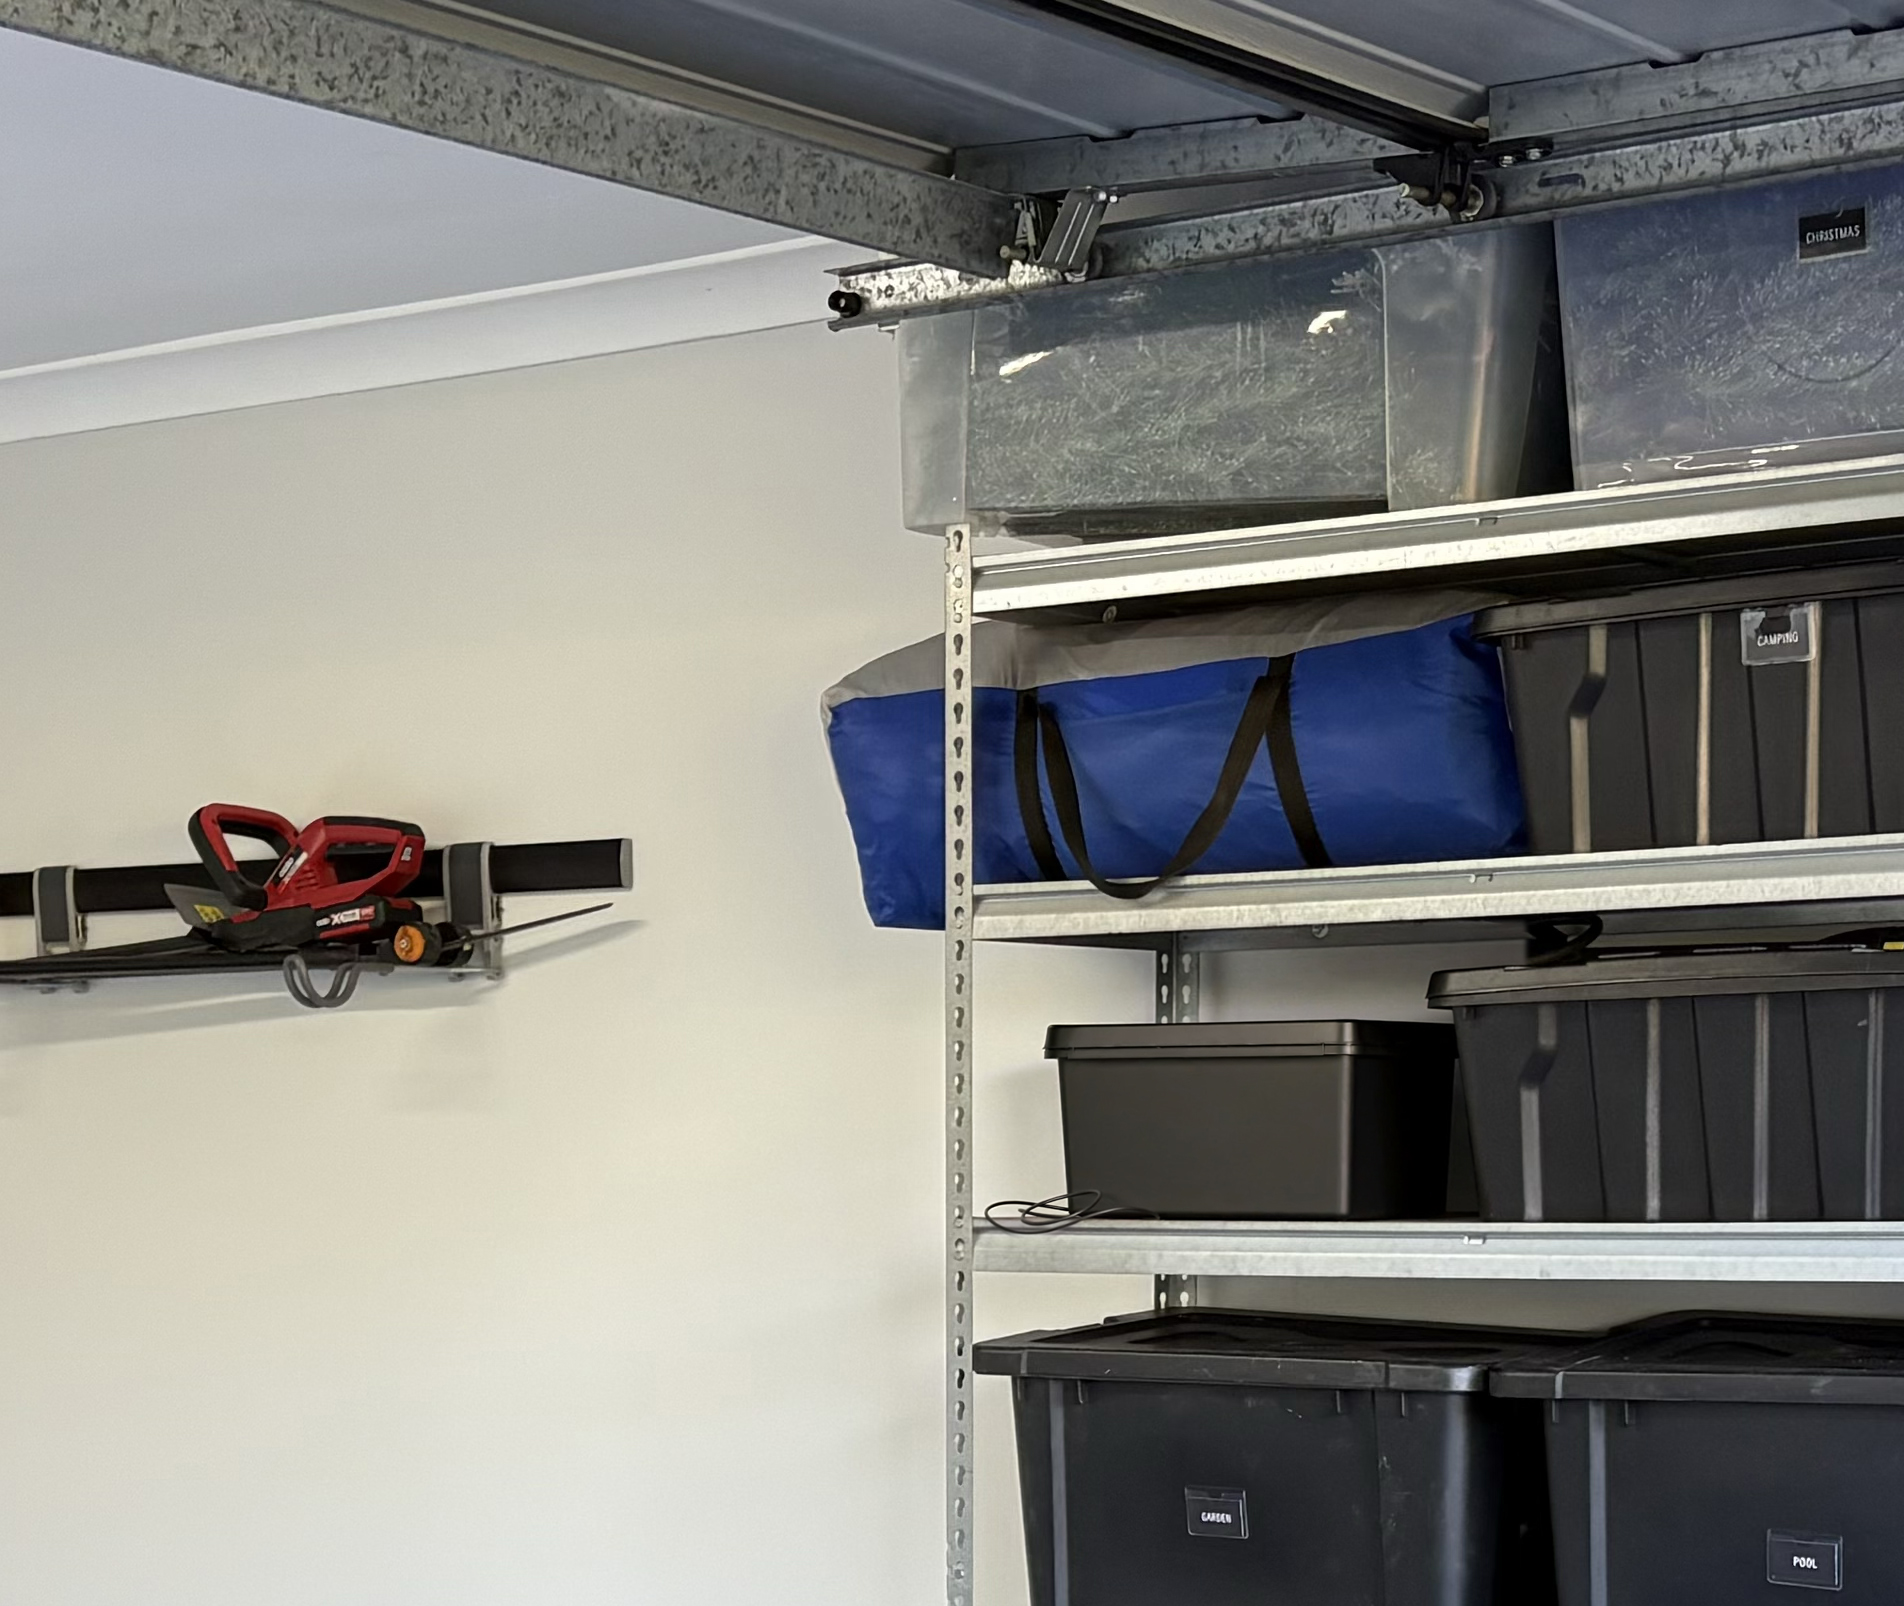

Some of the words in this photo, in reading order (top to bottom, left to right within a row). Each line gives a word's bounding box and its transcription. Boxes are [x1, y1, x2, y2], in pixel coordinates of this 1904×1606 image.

[1806, 225, 1860, 245] CHRISTMAS
[1757, 631, 1799, 647] CAMPING
[1793, 1556, 1818, 1569] POOL
